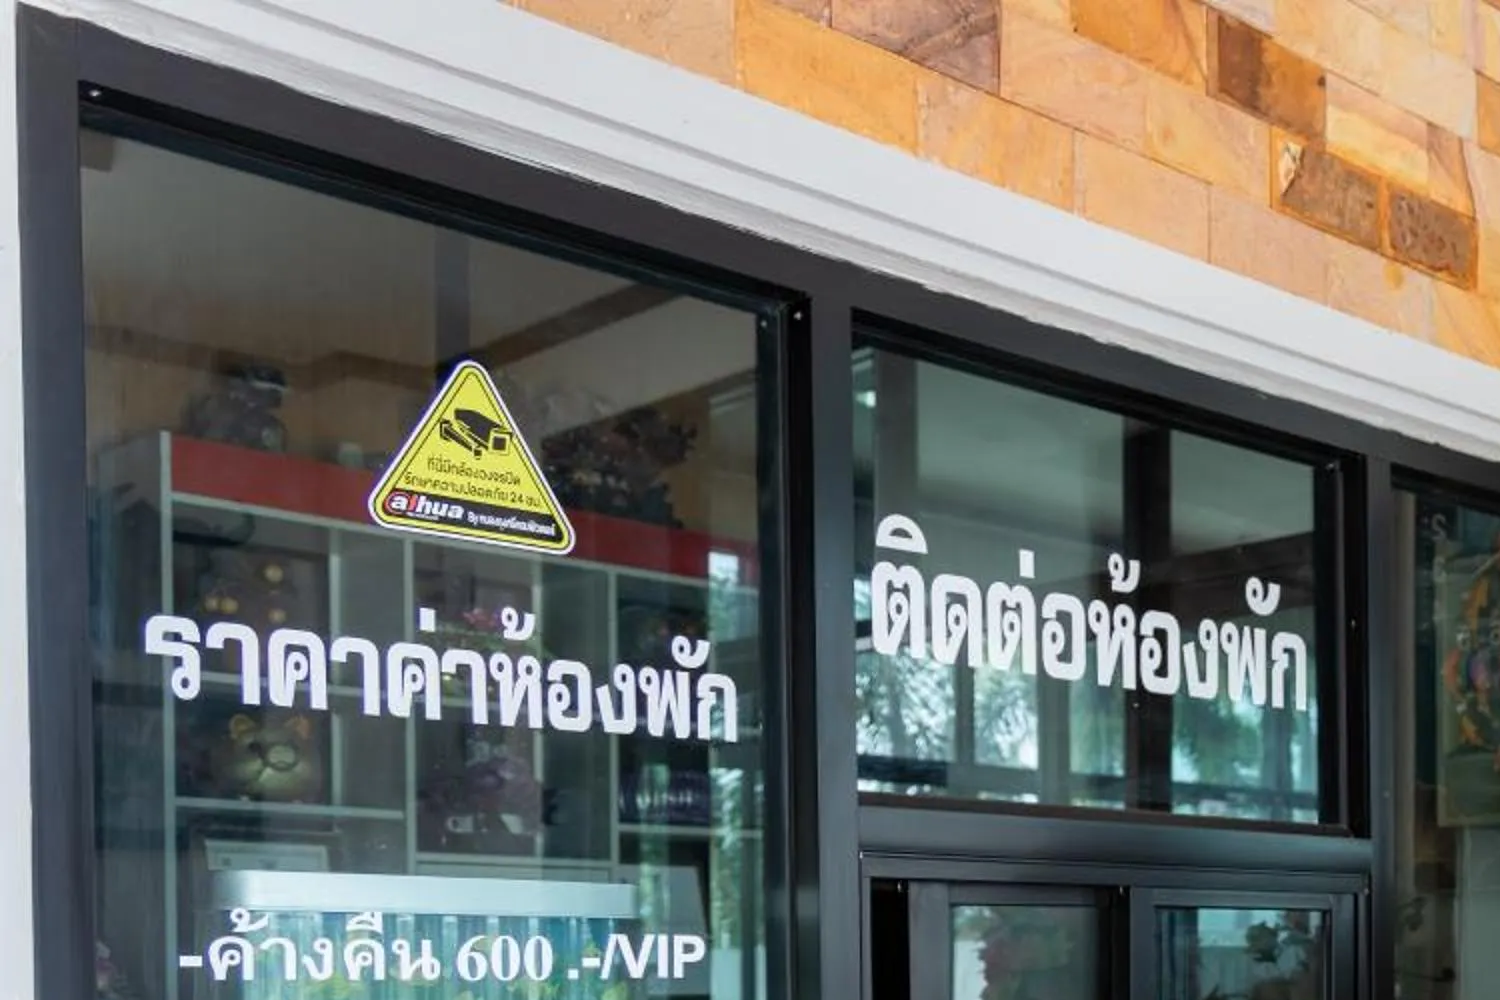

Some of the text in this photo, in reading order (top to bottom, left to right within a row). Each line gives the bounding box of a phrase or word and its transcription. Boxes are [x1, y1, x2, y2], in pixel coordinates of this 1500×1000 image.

[144, 606, 738, 743] ราคาค่าห้องพัก
[870, 513, 1308, 712] ติดต่อห้องพัก
[456, 933, 553, 982] 600
